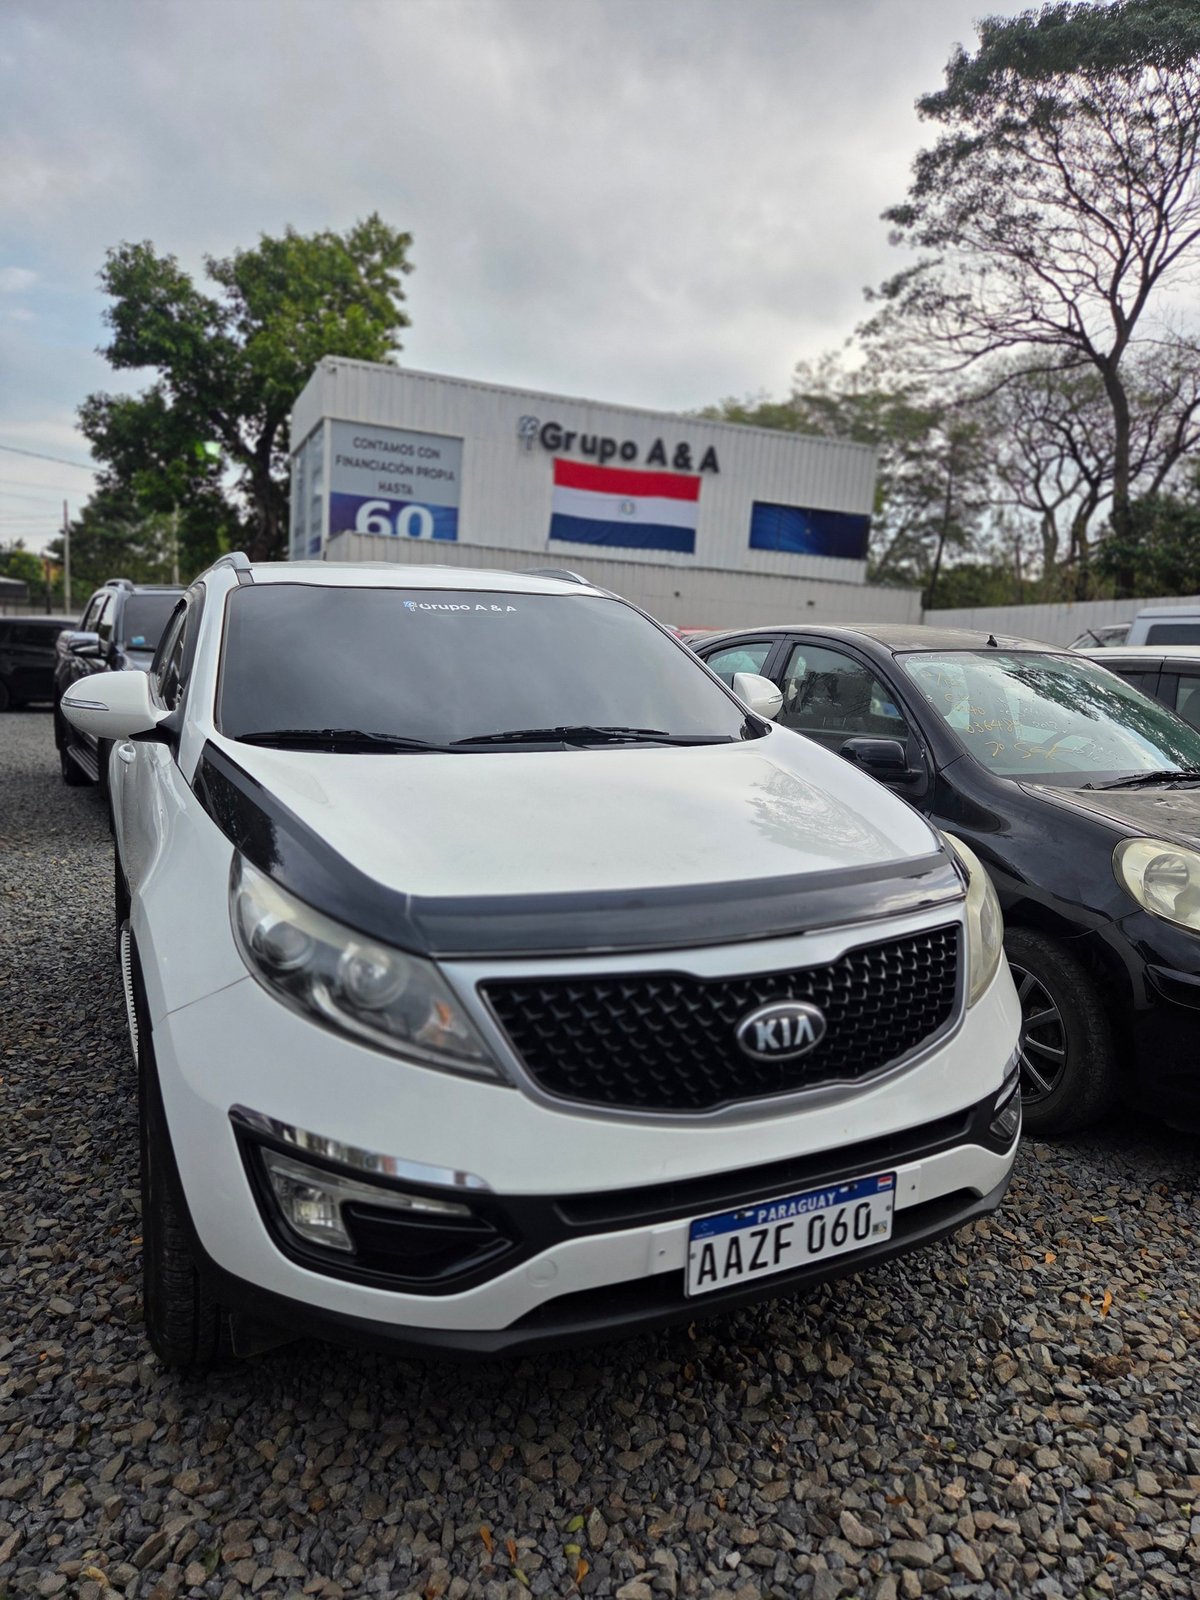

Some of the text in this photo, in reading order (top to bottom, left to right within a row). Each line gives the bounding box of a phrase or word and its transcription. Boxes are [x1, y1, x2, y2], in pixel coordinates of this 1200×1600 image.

[353, 436, 441, 459] CONTAMOS CON
[540, 422, 720, 474] Grupo A & A
[335, 454, 455, 481] FINANCIACIÓN PROPIA
[378, 481, 414, 495] HASTA
[355, 500, 434, 540] 60
[418, 602, 518, 612] Grupo A & A
[754, 1013, 815, 1051] KIA
[757, 1191, 836, 1224] PARAGUAY
[697, 1201, 872, 1286] AAZF 060
